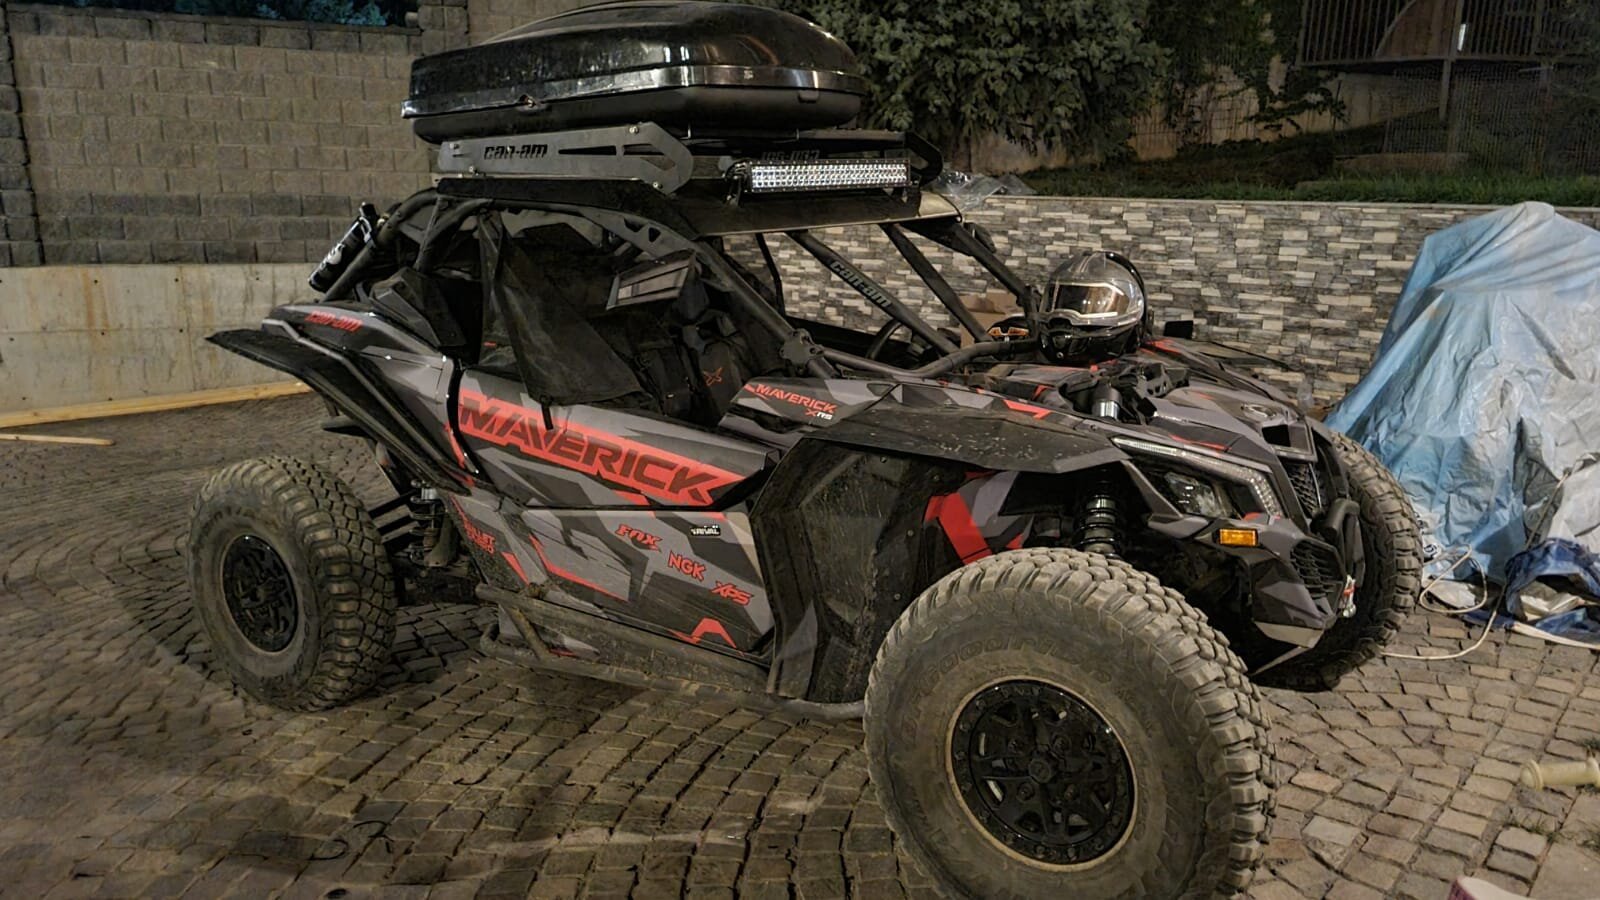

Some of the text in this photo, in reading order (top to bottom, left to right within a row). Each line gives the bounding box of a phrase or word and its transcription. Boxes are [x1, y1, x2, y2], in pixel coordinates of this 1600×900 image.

[756, 383, 837, 414] MAVERICK
[458, 395, 717, 501] MAVERICK
[616, 524, 662, 551] FOX
[668, 550, 705, 580] NGK
[712, 581, 753, 606] XPS
